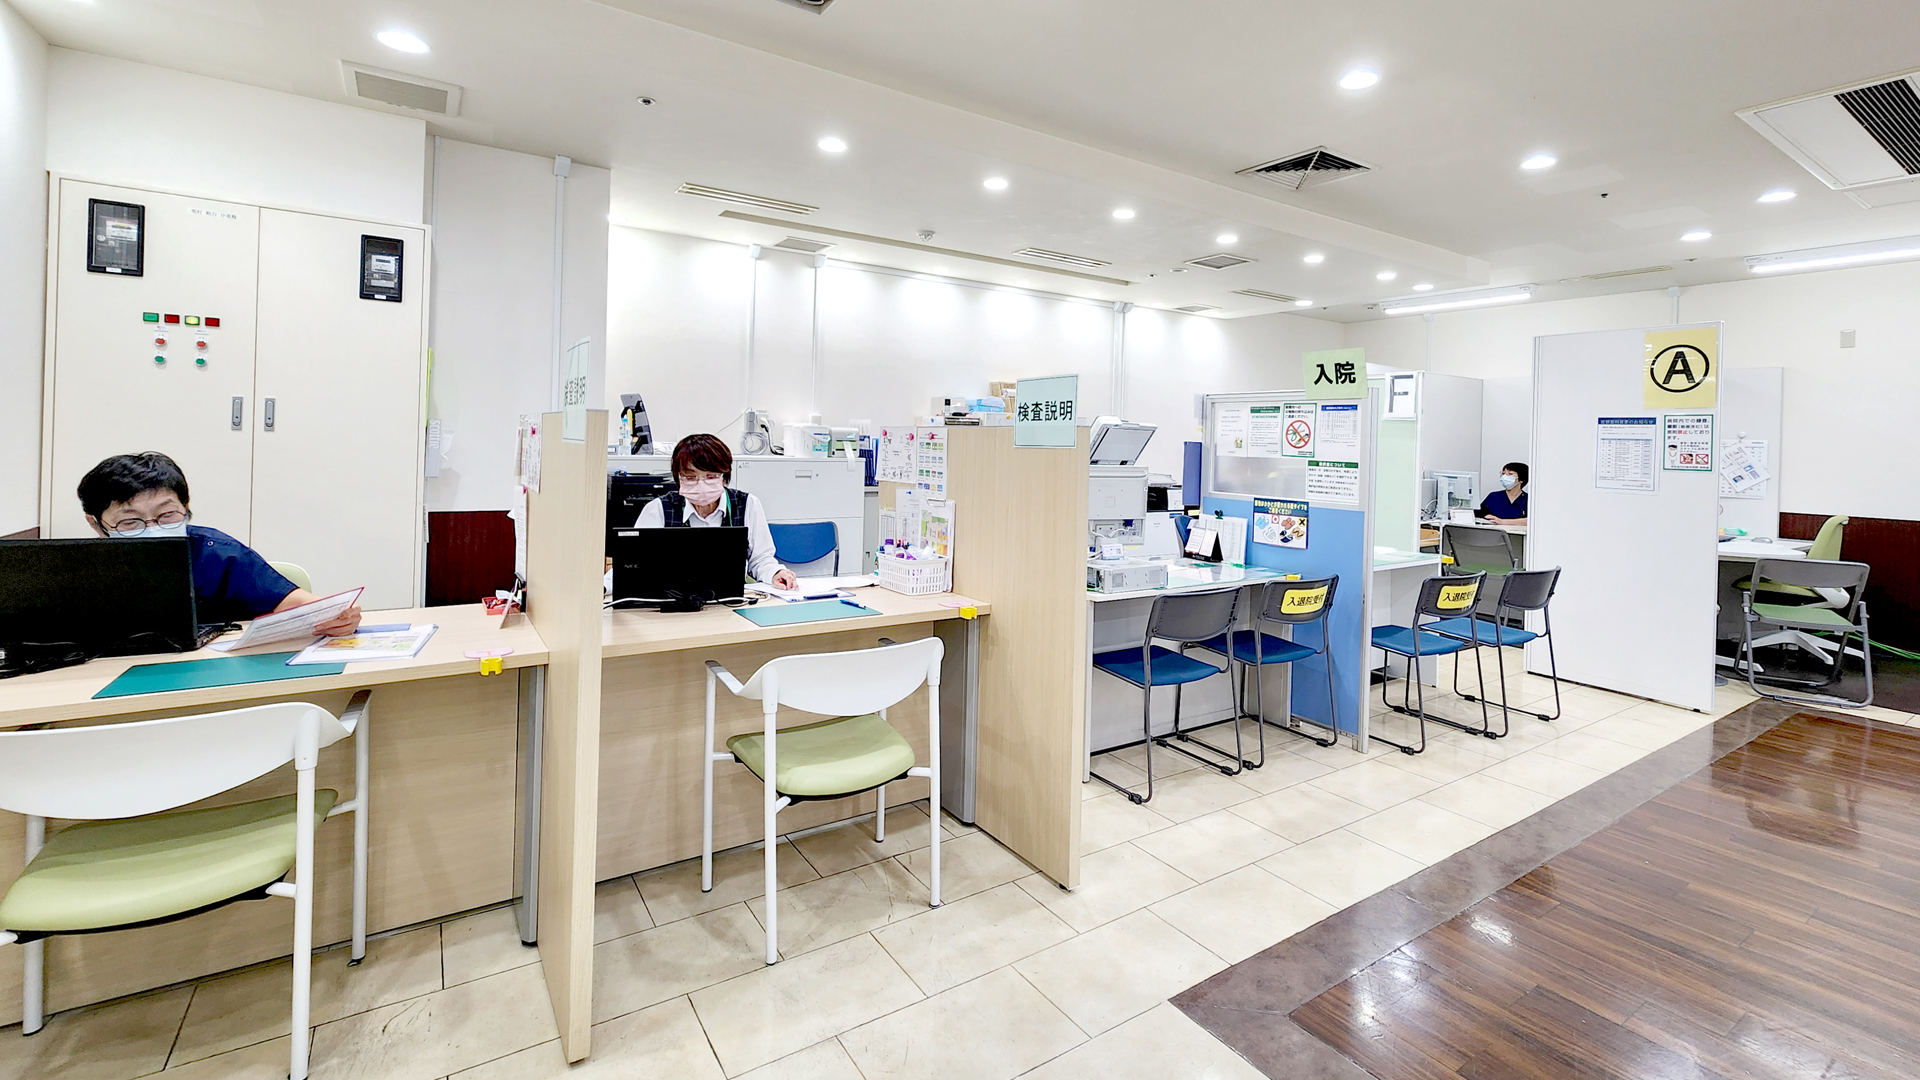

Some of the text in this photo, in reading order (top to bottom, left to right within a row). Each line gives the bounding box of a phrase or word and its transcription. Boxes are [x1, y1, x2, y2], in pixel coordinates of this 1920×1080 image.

[1314, 361, 1357, 386] 入院
[1662, 351, 1696, 385] A
[1388, 374, 1414, 413] F
[1018, 402, 1073, 422] 検査説明
[1286, 592, 1325, 607] 入退院受付
